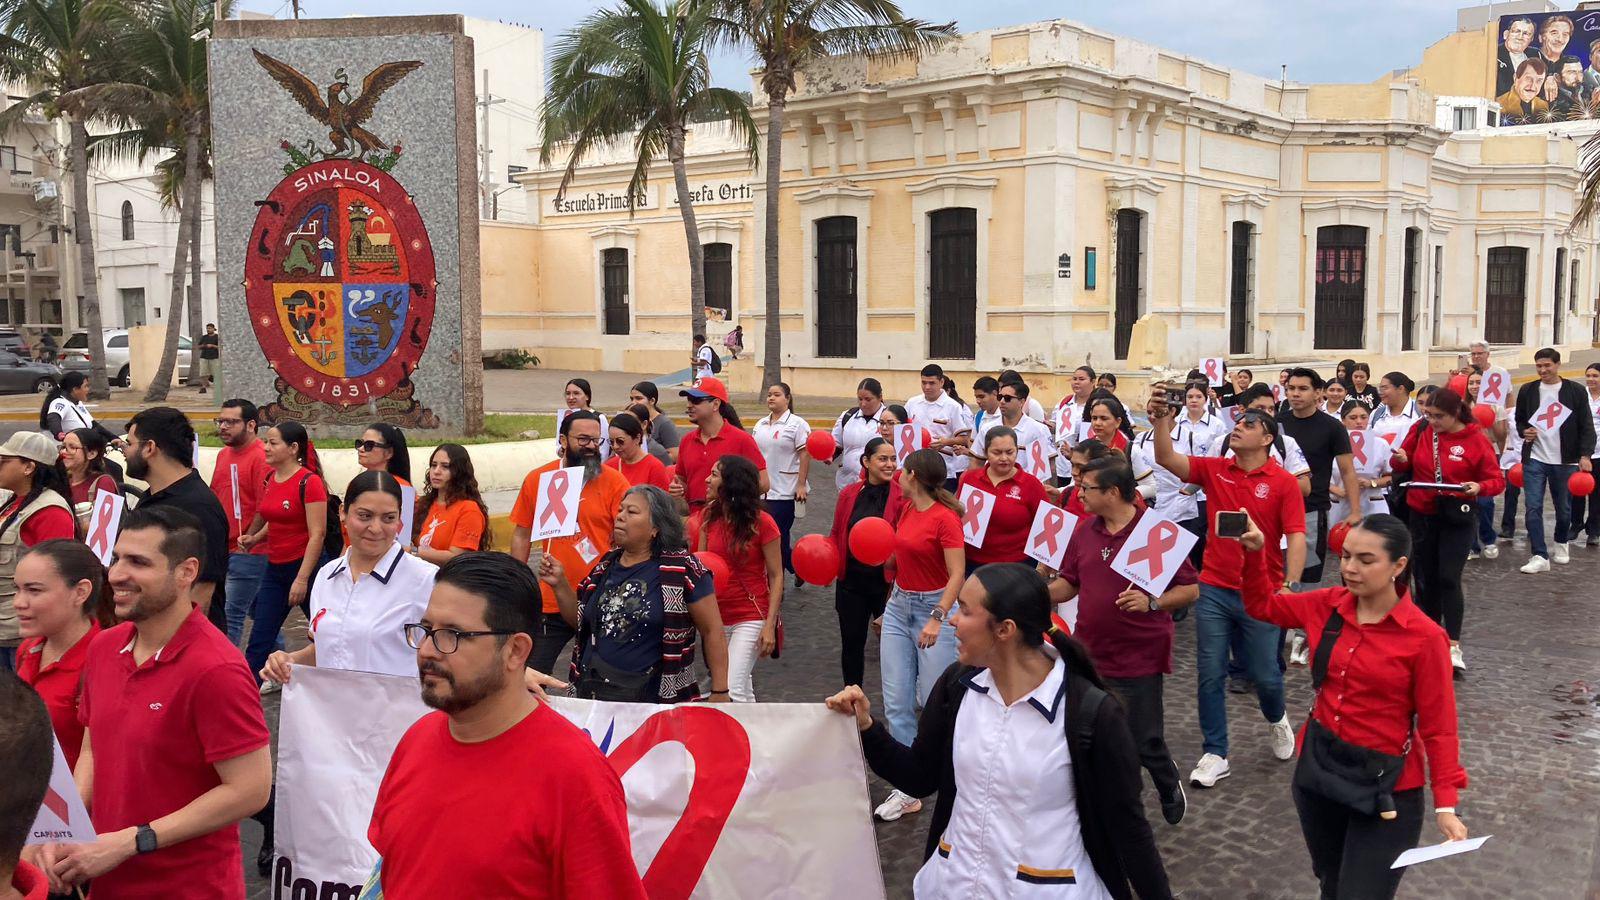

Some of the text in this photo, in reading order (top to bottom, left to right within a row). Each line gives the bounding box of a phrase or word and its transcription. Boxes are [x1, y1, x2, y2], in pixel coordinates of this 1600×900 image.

[294, 168, 380, 192] SINALOA
[552, 193, 595, 213] Escuela
[674, 185, 713, 203] sefa
[320, 382, 370, 396] 1831
